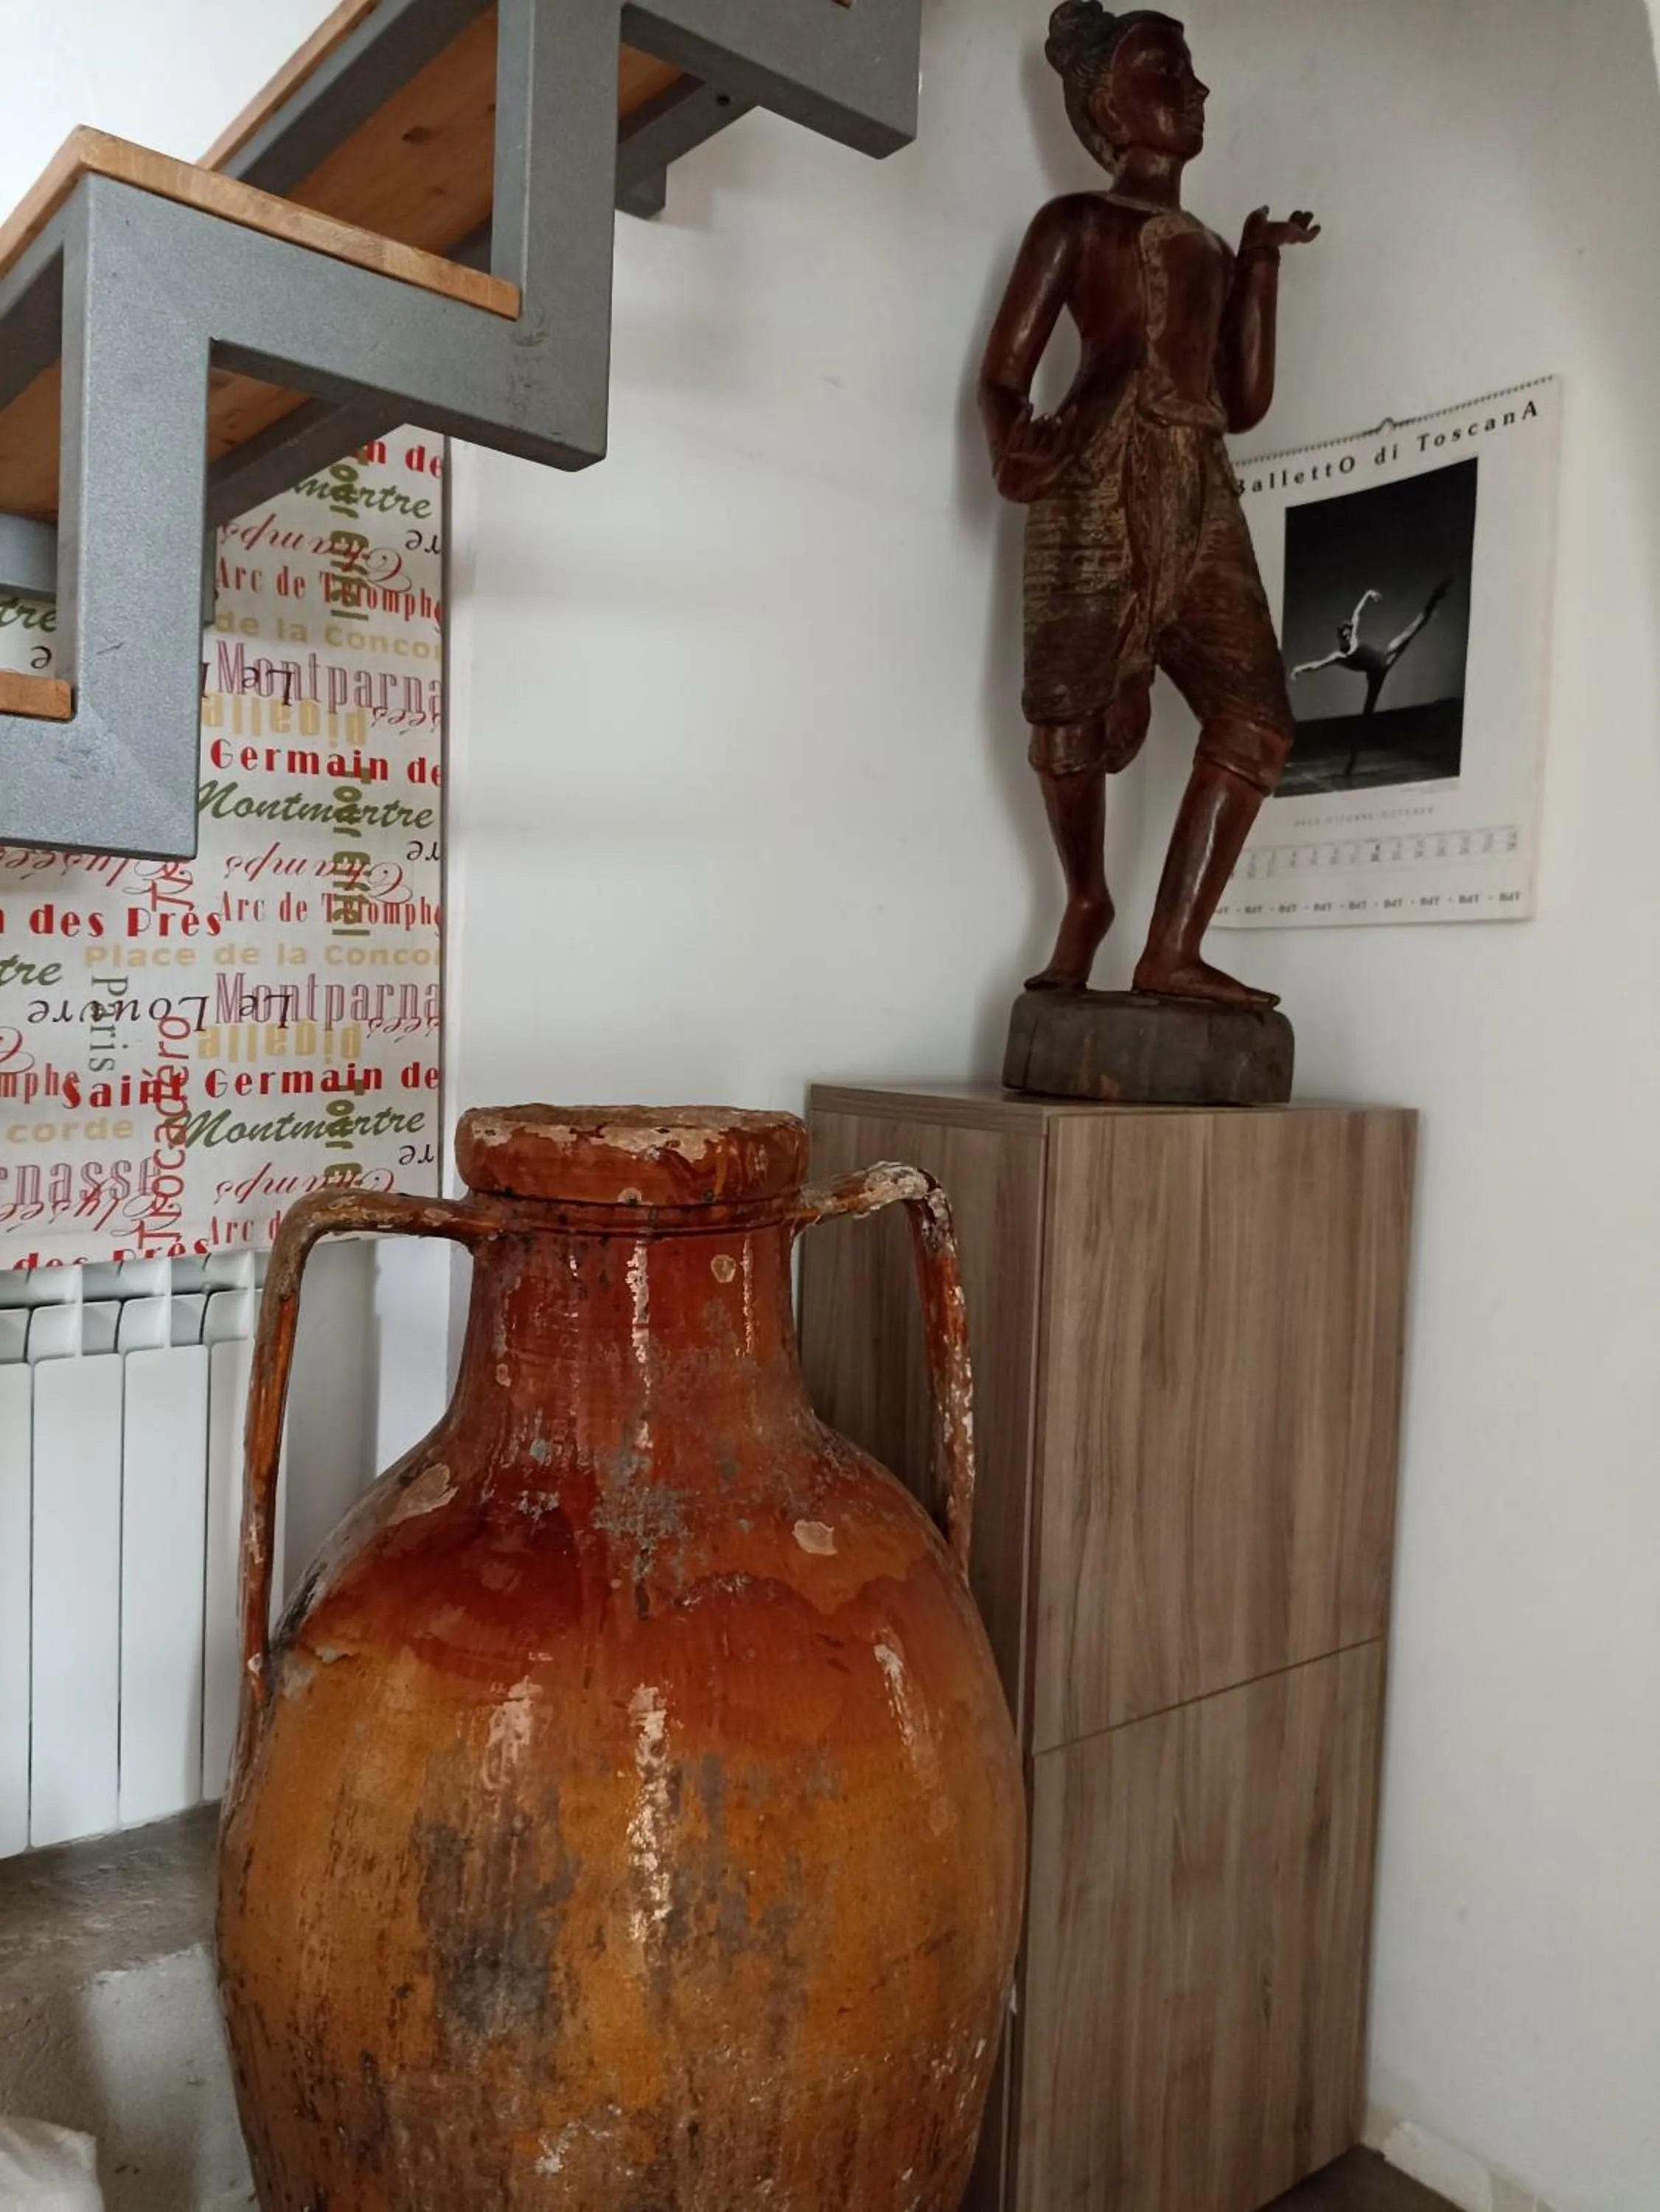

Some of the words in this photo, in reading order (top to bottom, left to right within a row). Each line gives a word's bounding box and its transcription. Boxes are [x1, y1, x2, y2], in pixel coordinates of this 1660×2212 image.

[1374, 445, 1398, 466] di
[216, 557, 262, 593] Arc
[277, 565, 305, 598] de
[215, 610, 259, 636] de
[276, 616, 307, 643] la
[211, 738, 388, 782] Germain
[198, 779, 435, 830] Montmartre
[29, 904, 104, 937] des
[220, 891, 264, 922] Arc
[279, 891, 307, 922] de
[84, 945, 196, 968] Place
[214, 943, 260, 966] de
[276, 943, 307, 966] la
[27, 995, 210, 1032] Louvre
[88, 975, 129, 1072] Paris
[62, 1071, 186, 1110] Saint
[204, 1062, 383, 1098] Germain
[165, 1107, 426, 1149] Montmartre
[208, 1214, 254, 1247] Arc
